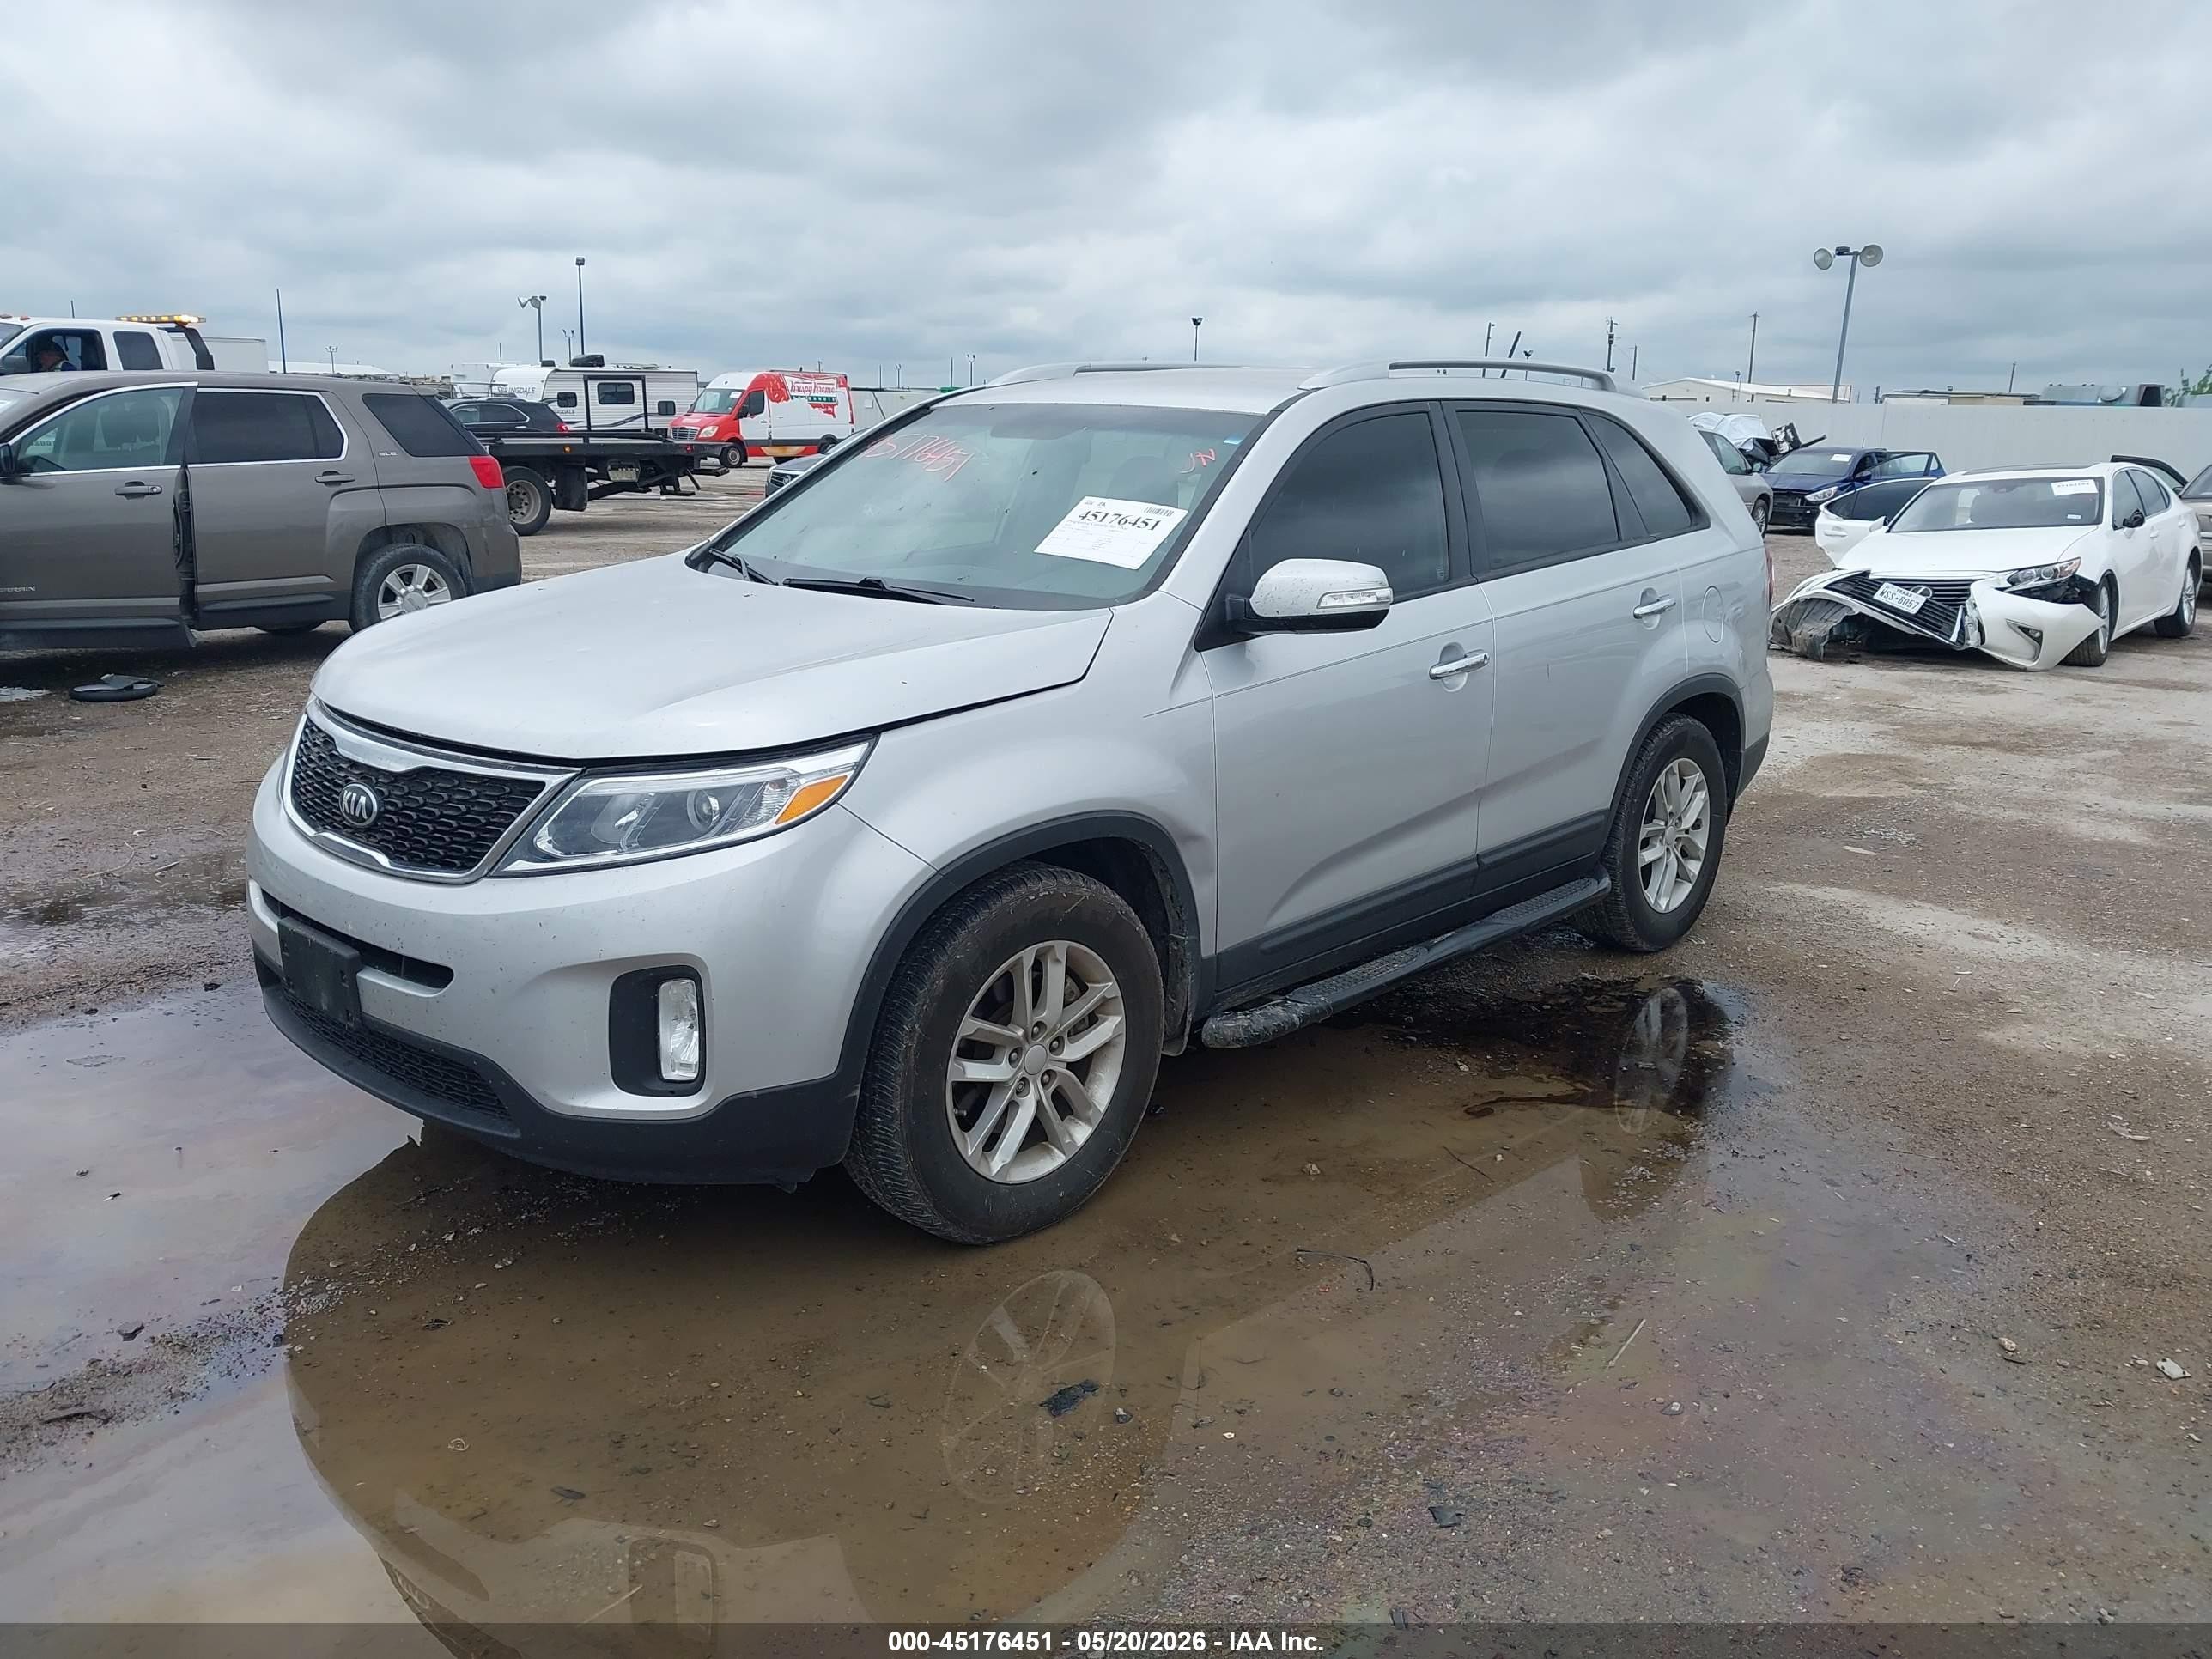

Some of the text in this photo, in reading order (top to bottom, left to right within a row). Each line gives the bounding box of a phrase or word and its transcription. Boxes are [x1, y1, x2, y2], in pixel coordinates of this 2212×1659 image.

[1079, 510, 1161, 532] 45176451
[1896, 588, 1912, 598] TEXAS
[342, 789, 368, 820] KIA
